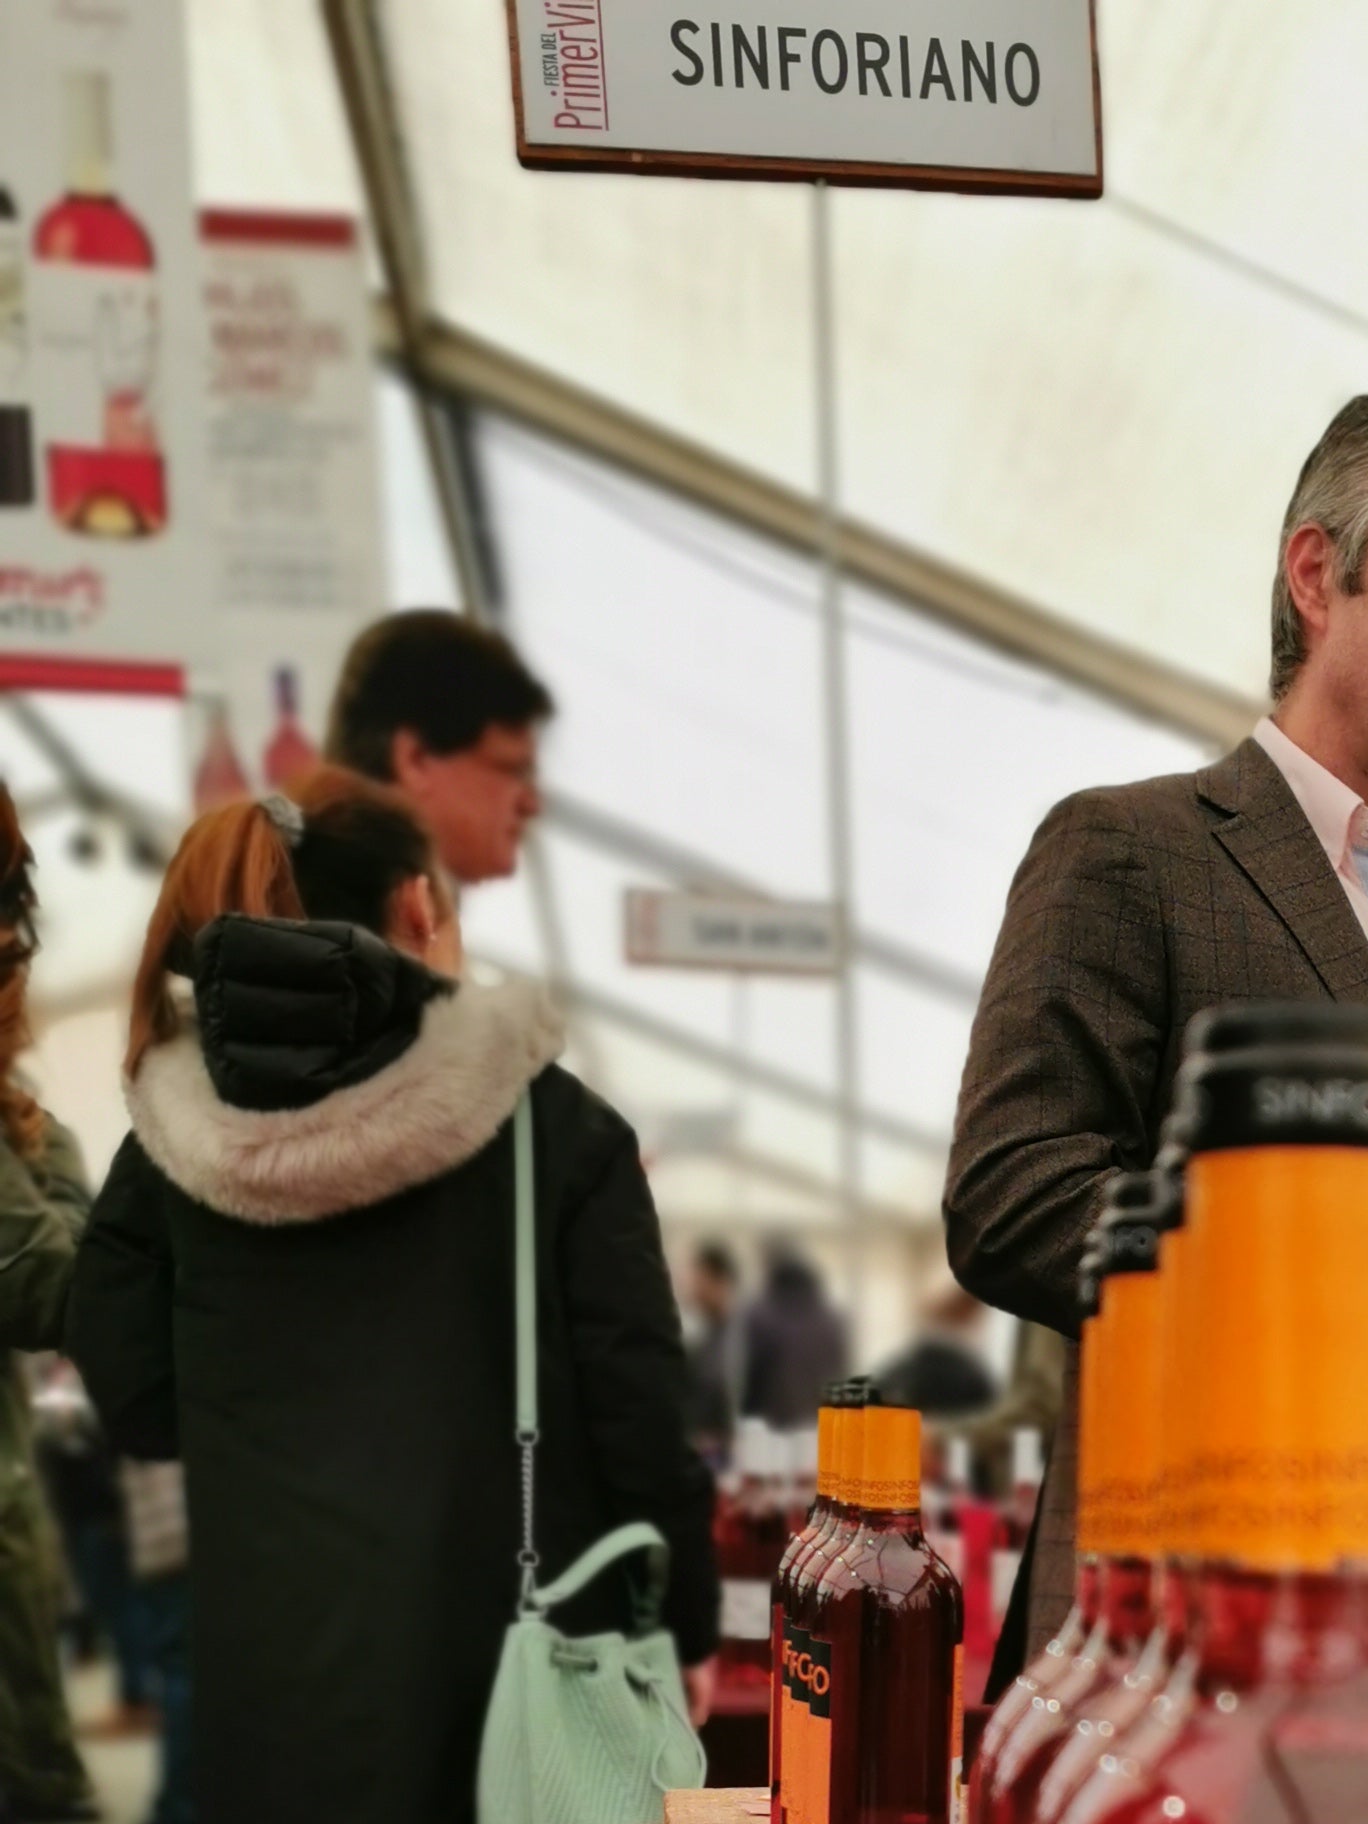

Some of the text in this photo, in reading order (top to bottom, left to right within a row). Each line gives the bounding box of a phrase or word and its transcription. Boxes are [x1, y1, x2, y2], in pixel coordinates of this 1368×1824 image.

[541, 32, 559, 87] FIESTA DEL
[545, 0, 603, 130] PrimerVi
[670, 19, 1041, 107] SINFORIANO
